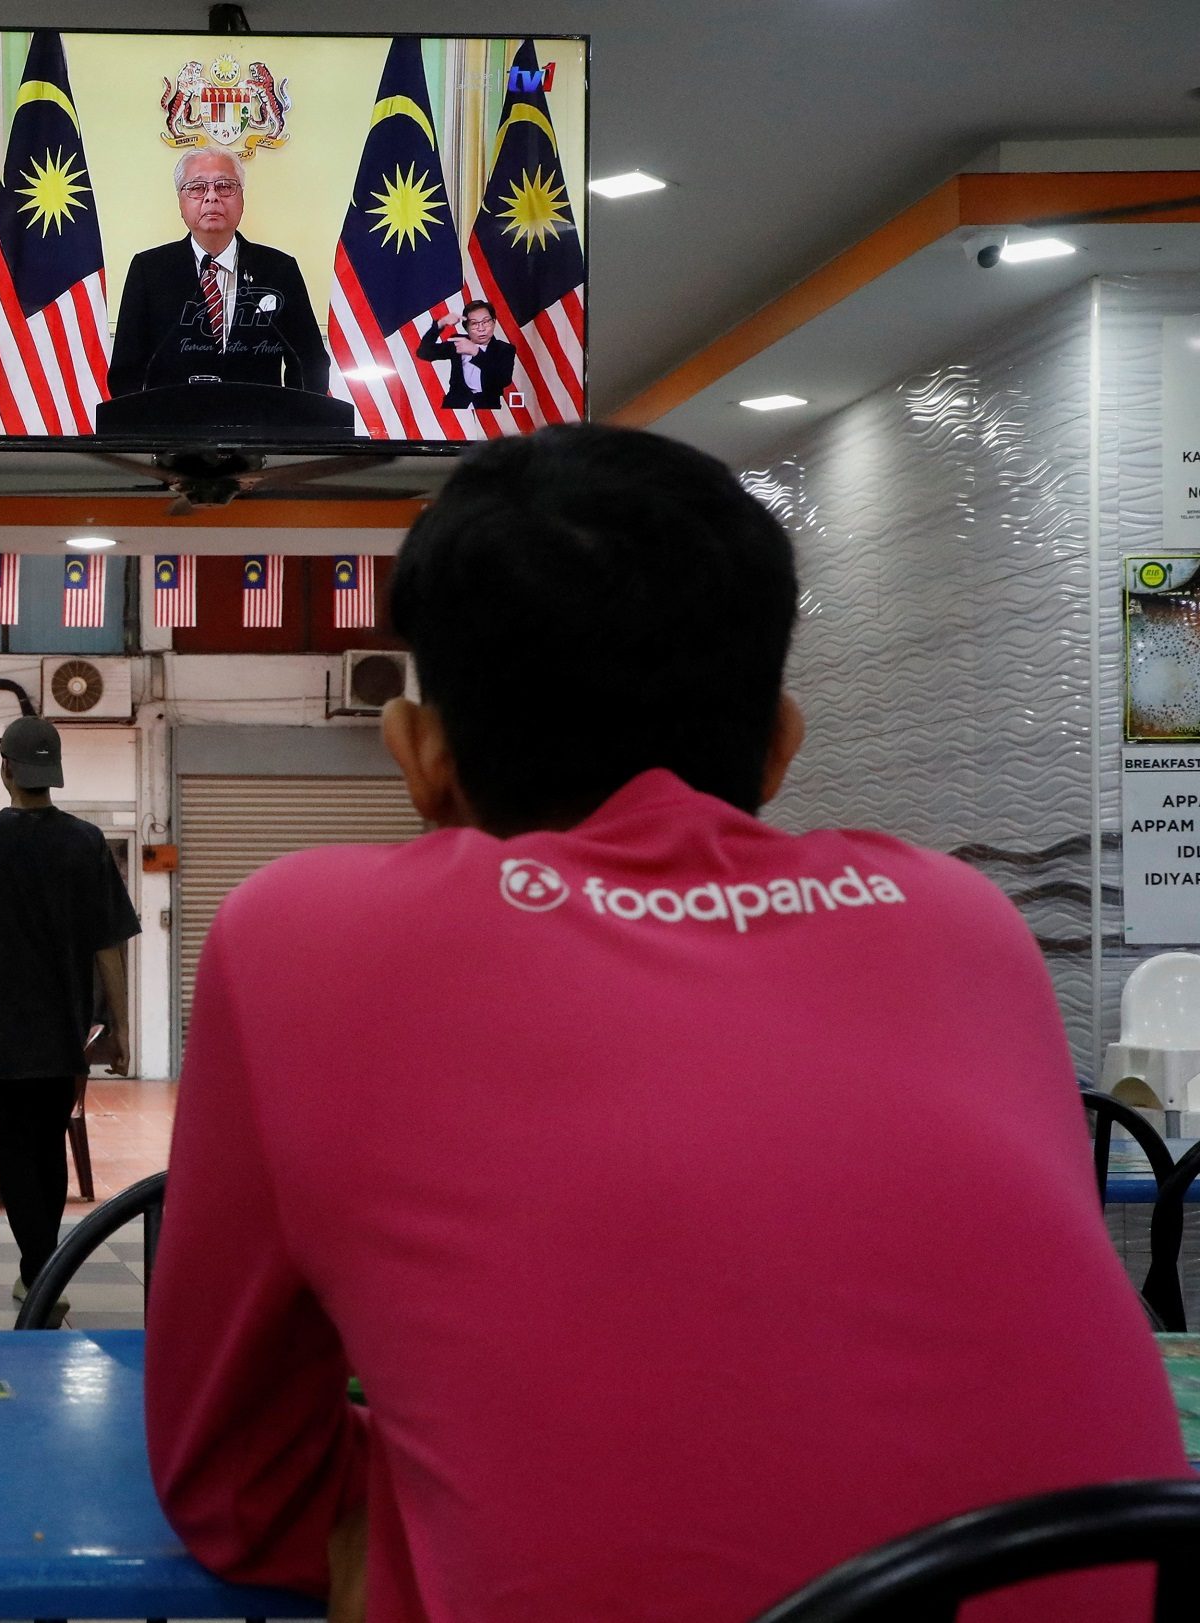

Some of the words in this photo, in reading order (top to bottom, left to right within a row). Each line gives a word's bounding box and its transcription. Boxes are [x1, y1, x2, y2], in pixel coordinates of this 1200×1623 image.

[1162, 795, 1200, 807] APP
[1131, 820, 1194, 832] APPAM
[582, 865, 906, 933] foodpanda
